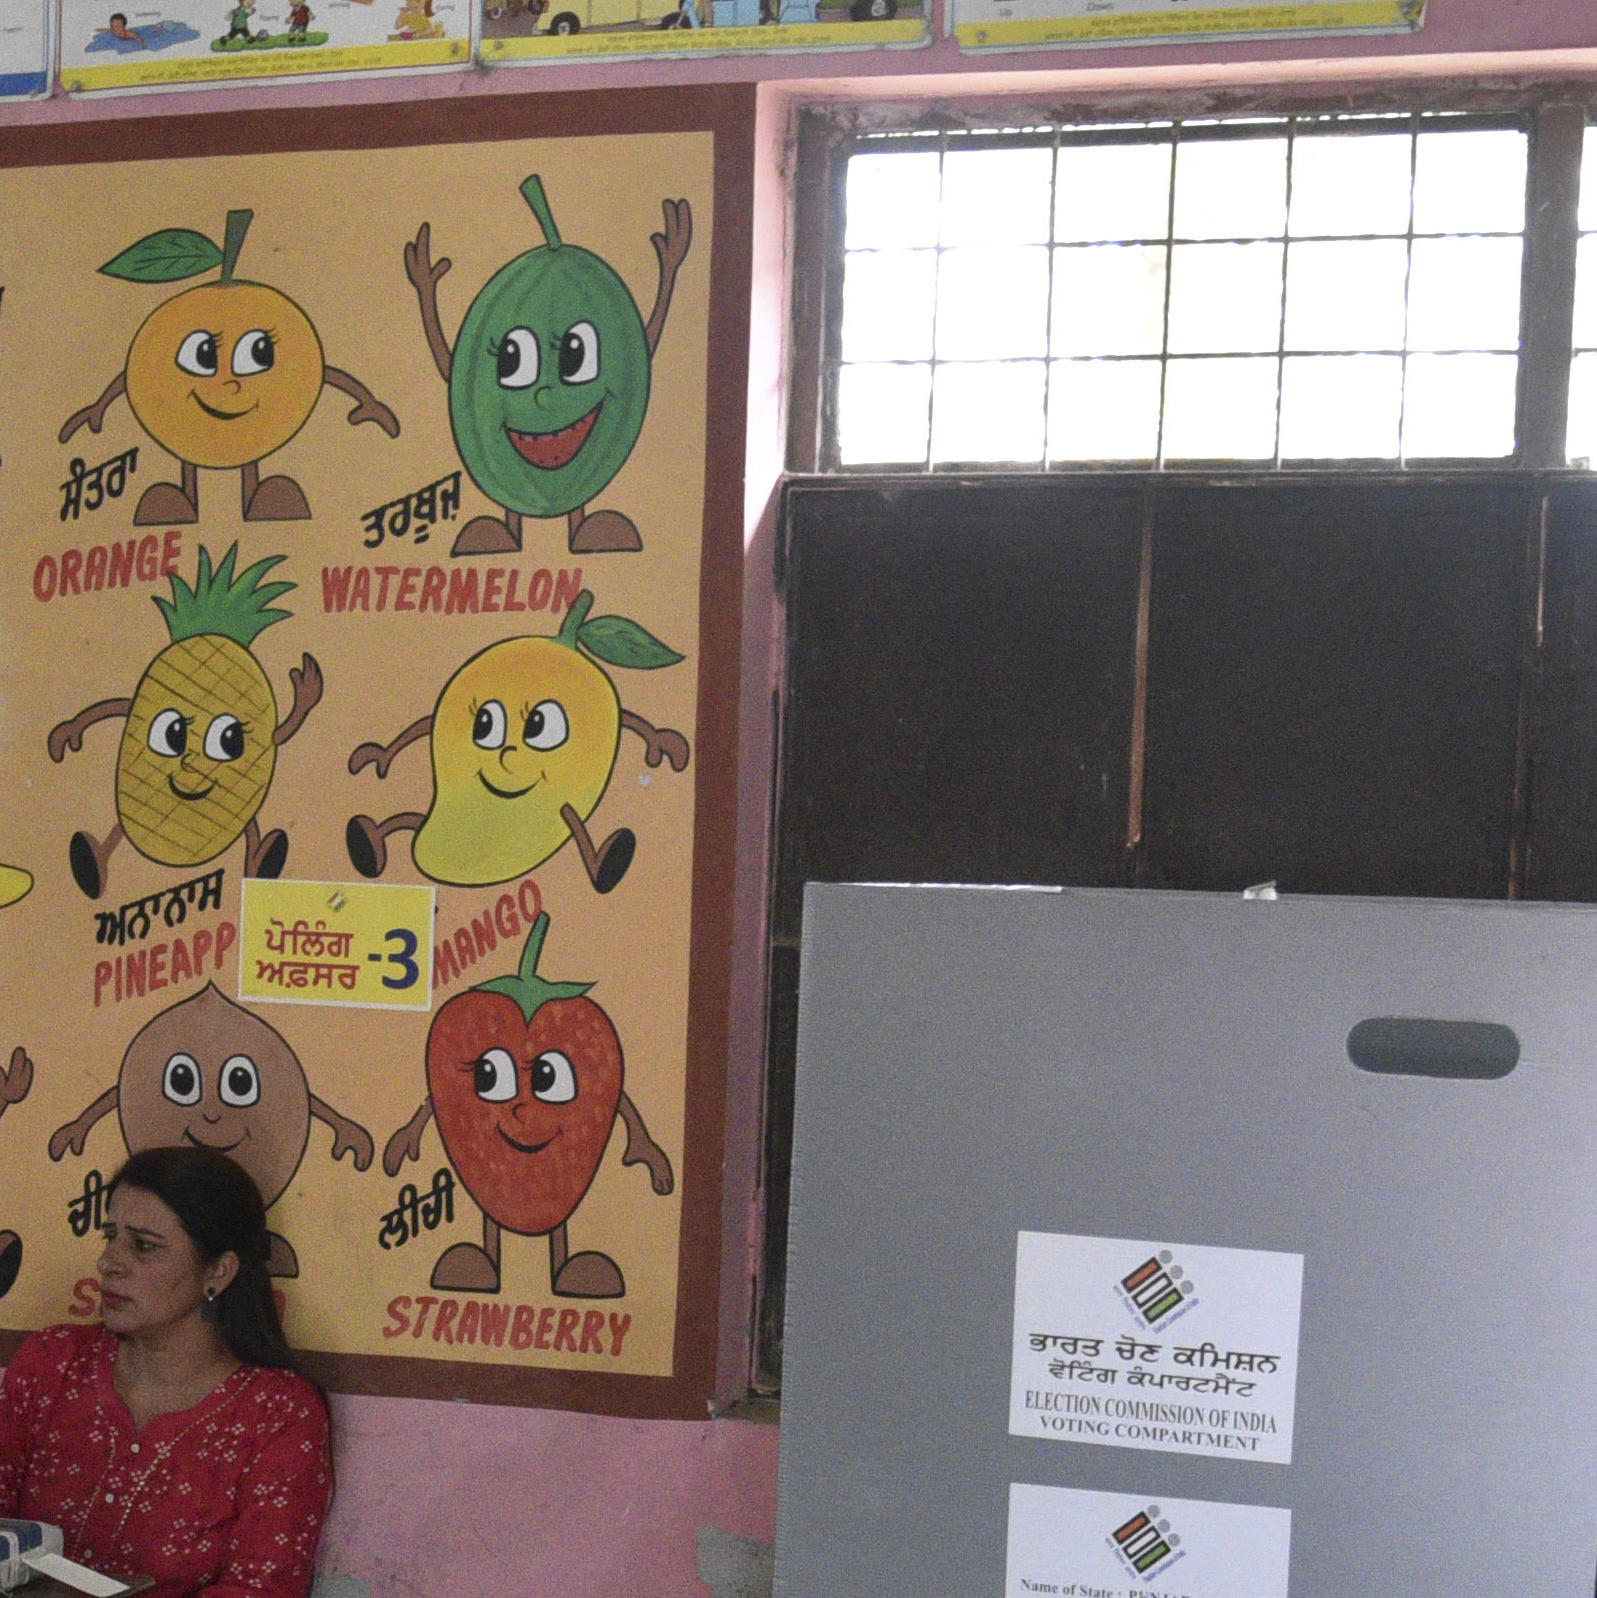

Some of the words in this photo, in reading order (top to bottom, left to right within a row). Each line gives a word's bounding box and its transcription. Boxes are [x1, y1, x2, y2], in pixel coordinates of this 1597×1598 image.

[60, 447, 139, 521] ਸੰਤਰਾ
[360, 470, 462, 549] ਤਰਬੂਜ਼
[32, 530, 183, 603] ORANGE
[321, 566, 583, 615] WATERMELON
[94, 868, 226, 947] ਅਨਾਨਾਸ
[263, 917, 355, 959] ਪੋਲਿੰਗ
[433, 878, 542, 990] MANGO
[93, 921, 238, 1008] PINEAPP
[378, 1167, 456, 1250] ਲੀਚੀ
[382, 1295, 632, 1357] STRAWBERRY
[1029, 1332, 1104, 1358] ਭਾਰਤ
[1114, 1333, 1163, 1363] ਚੋਣ
[1173, 1342, 1281, 1374] ਕਮਿਸ਼ਨ
[1048, 1358, 1118, 1385] ਵੋਟਿੰਗ
[1127, 1365, 1257, 1398] ਕੰਪਾਰਟਮੈਂਟ
[1025, 1389, 1102, 1415] ELECTION
[1104, 1398, 1203, 1426] COMMISSION
[1208, 1408, 1230, 1429] OF
[1233, 1410, 1277, 1434] INDIA
[1040, 1415, 1110, 1437] VOTING
[1114, 1423, 1261, 1452] COMPARTMENT
[1020, 1578, 1059, 1595] Name
[1062, 1584, 1076, 1596] of
